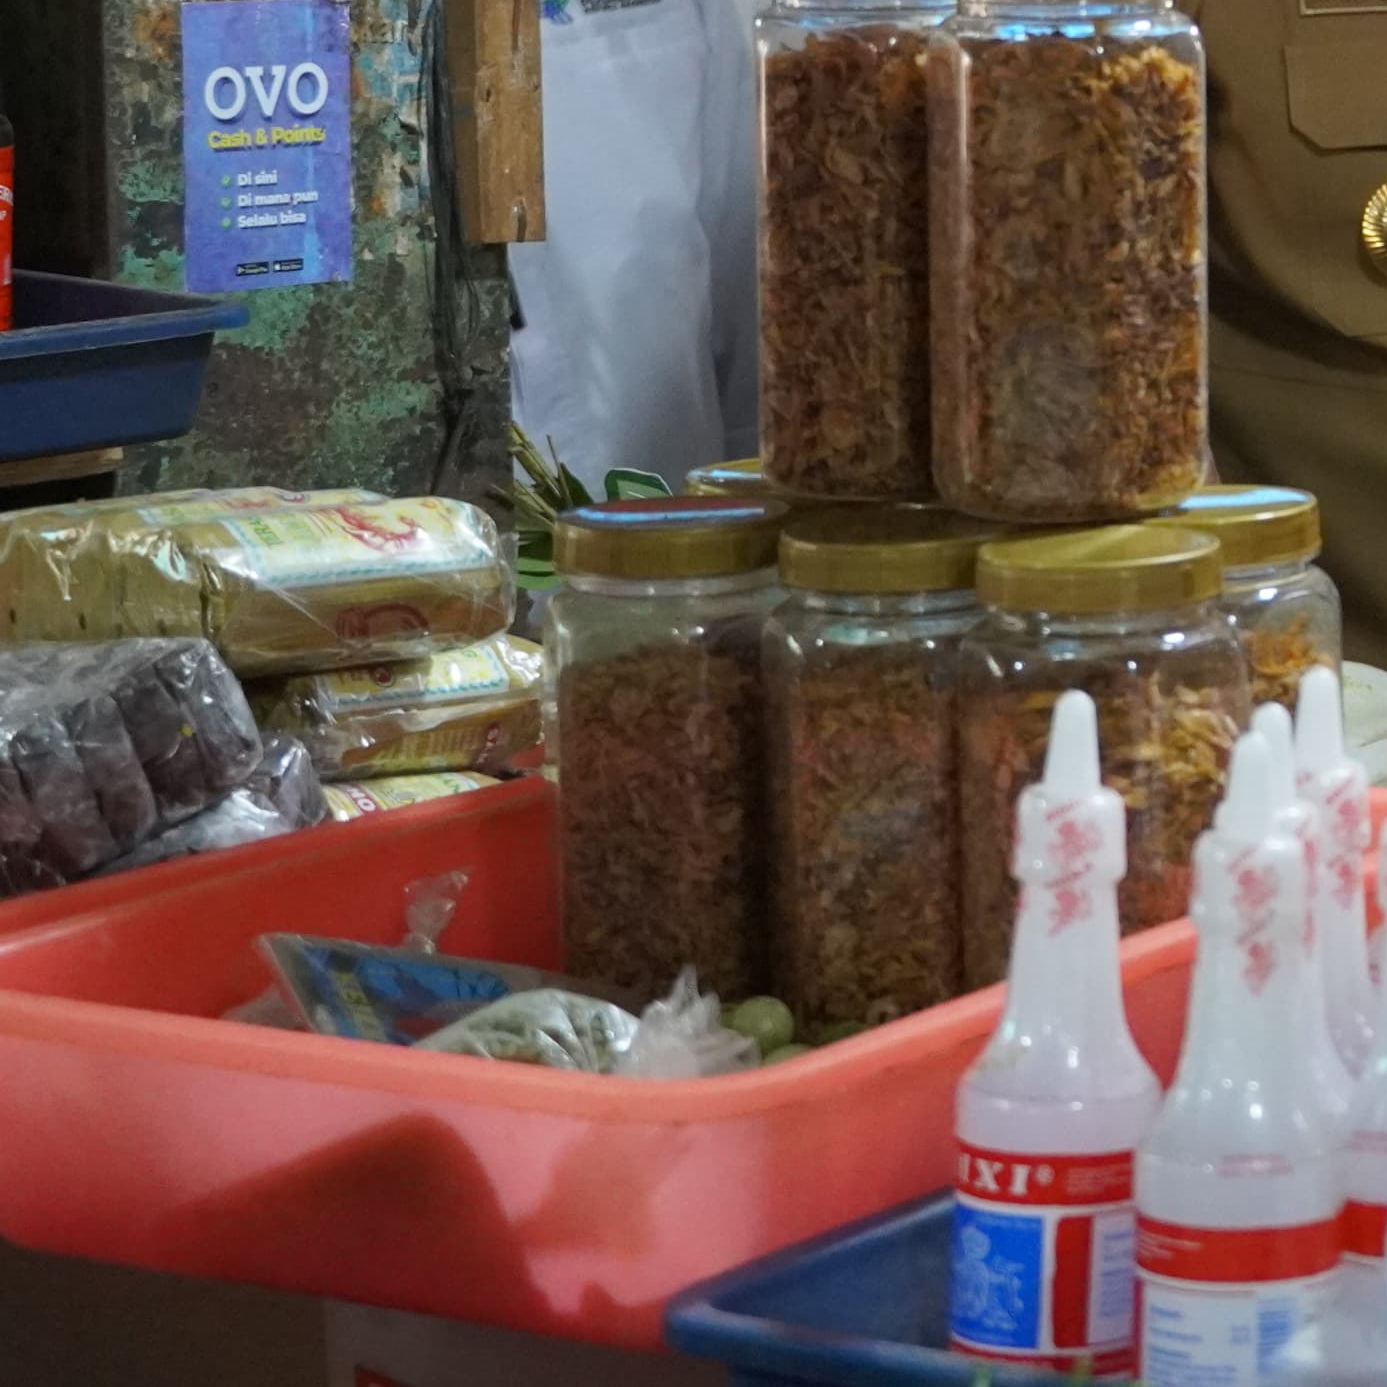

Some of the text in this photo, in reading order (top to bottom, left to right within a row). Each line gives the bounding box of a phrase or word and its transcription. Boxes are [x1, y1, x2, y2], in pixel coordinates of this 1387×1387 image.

[204, 62, 328, 120] OVO
[208, 124, 326, 149] Cash & Points
[238, 169, 278, 186] Di sini
[238, 193, 252, 206] Di
[293, 191, 319, 205] pun
[238, 214, 278, 228] Selalu
